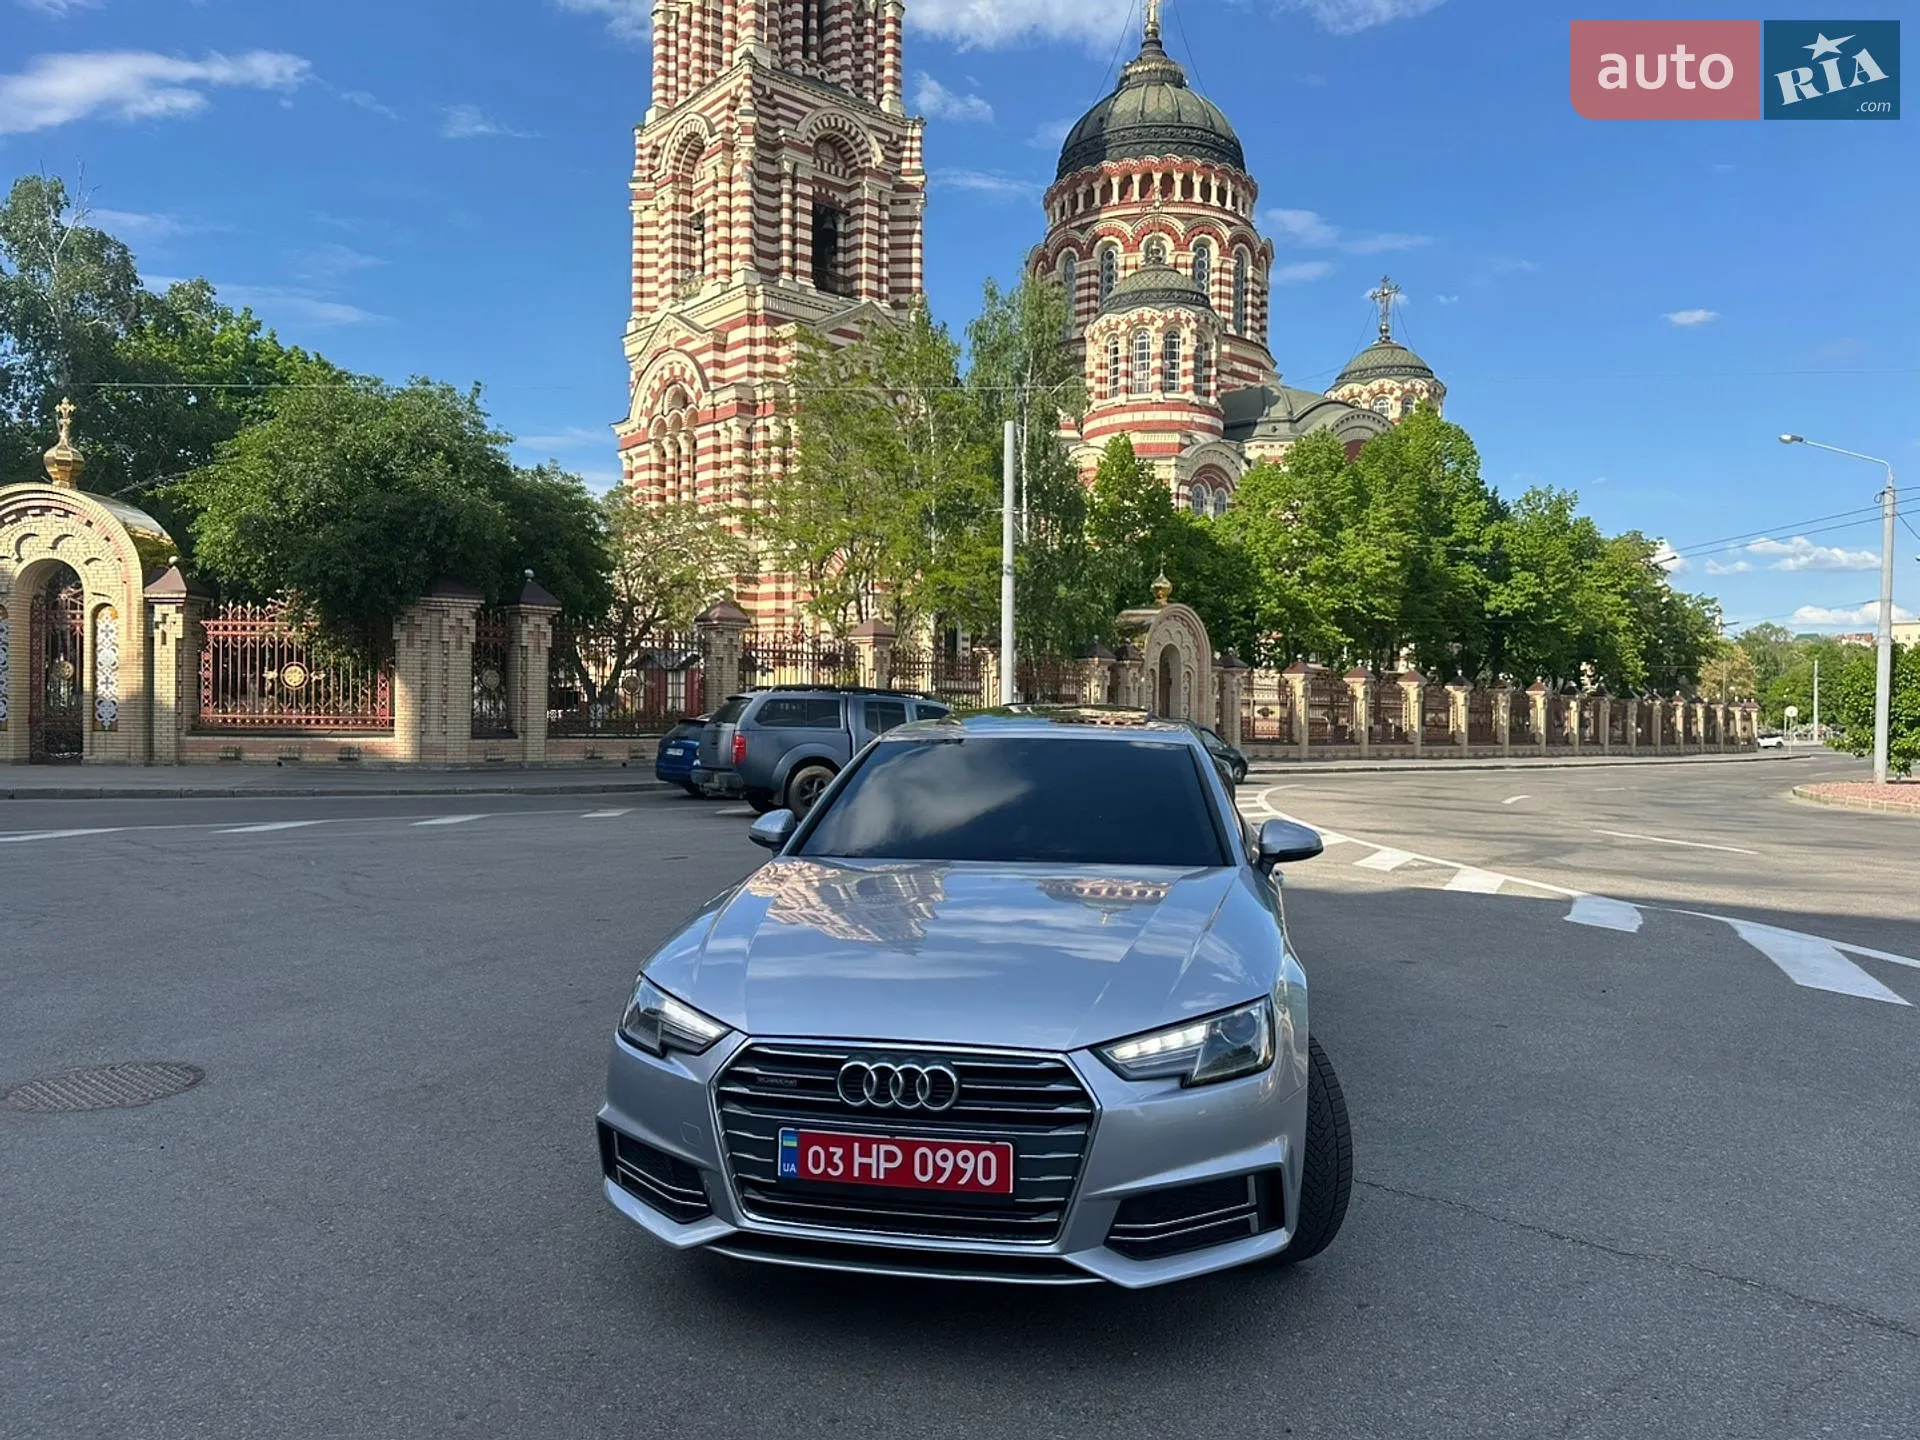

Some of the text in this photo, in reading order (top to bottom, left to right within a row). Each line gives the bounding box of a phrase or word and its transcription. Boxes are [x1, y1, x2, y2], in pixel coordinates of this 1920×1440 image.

[782, 1162, 797, 1174] UA
[807, 1142, 998, 1187] 03 HP 0990
